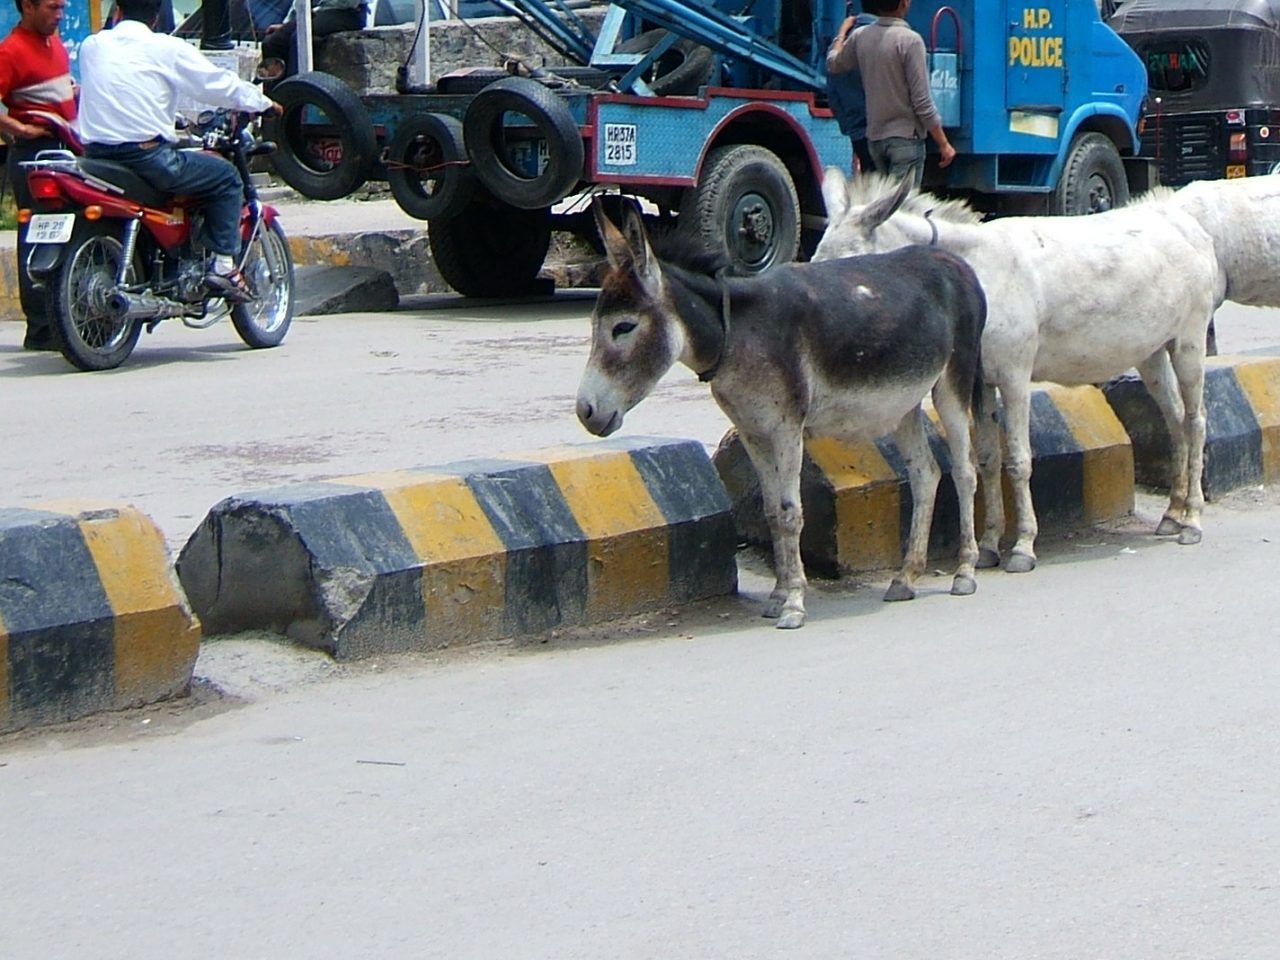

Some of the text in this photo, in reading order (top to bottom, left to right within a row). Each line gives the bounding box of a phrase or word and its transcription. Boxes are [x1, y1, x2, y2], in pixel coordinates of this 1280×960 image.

[1023, 8, 1053, 30] H.P.
[1009, 36, 1064, 67] POLICE
[607, 144, 632, 160] 2815
